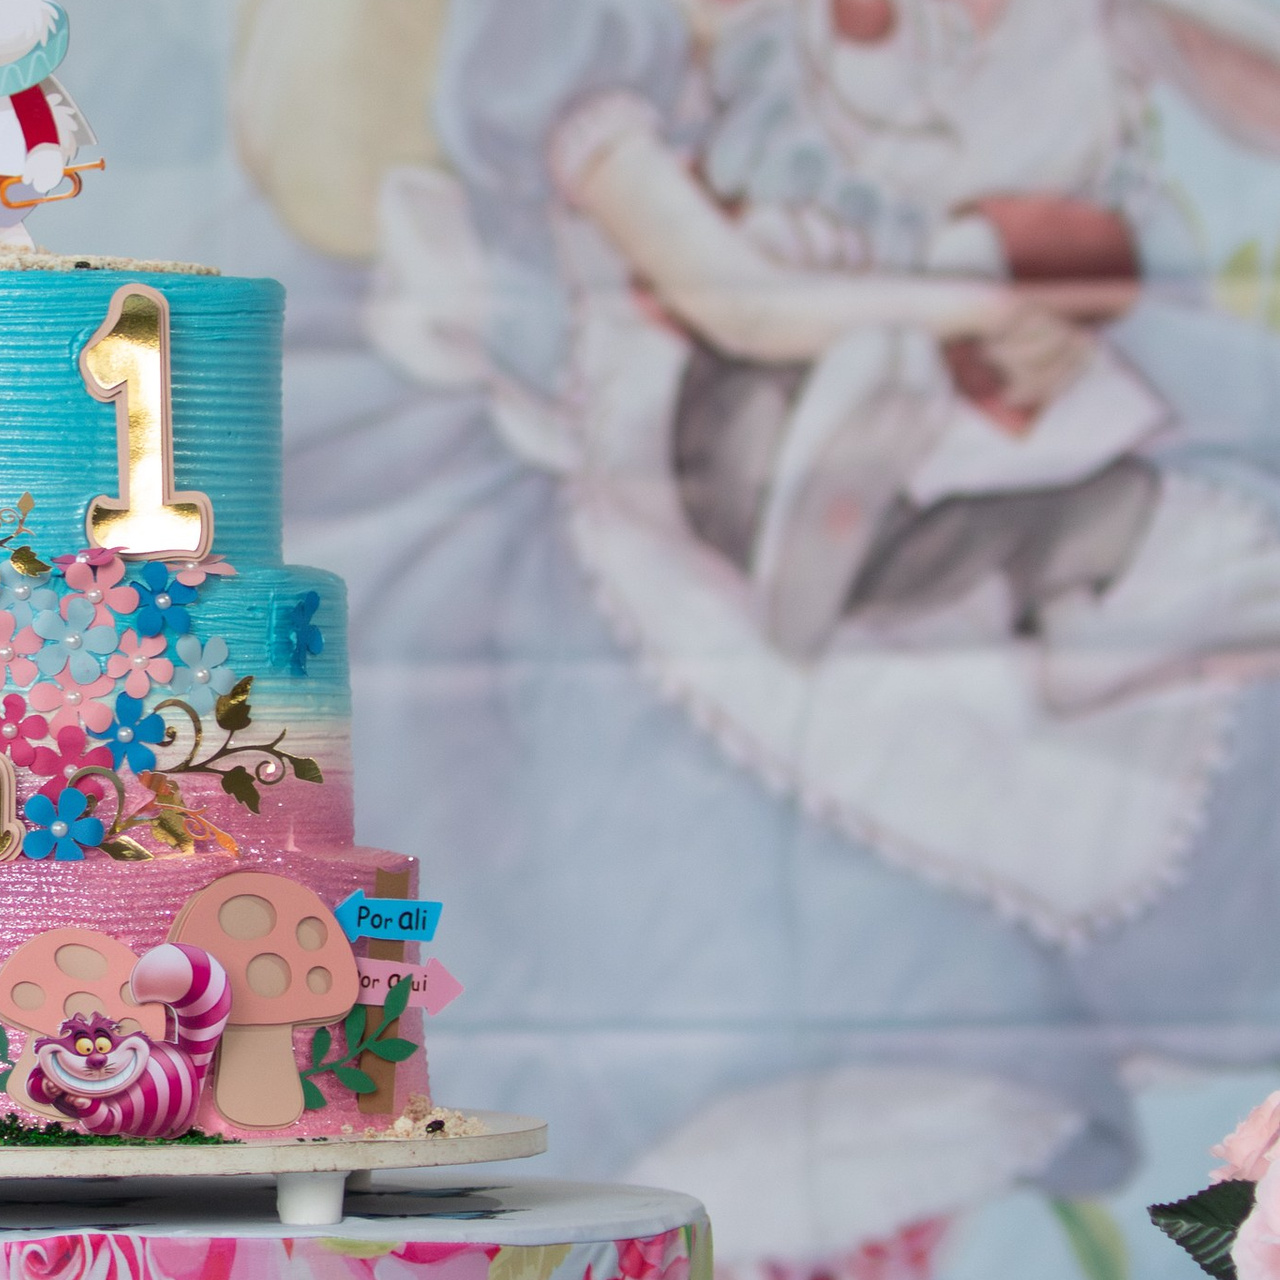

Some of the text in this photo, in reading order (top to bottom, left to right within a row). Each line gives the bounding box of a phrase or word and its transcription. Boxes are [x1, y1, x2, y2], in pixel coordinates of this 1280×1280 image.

[86, 294, 201, 554] 1
[357, 906, 428, 931] Por ali
[358, 970, 380, 989] or
